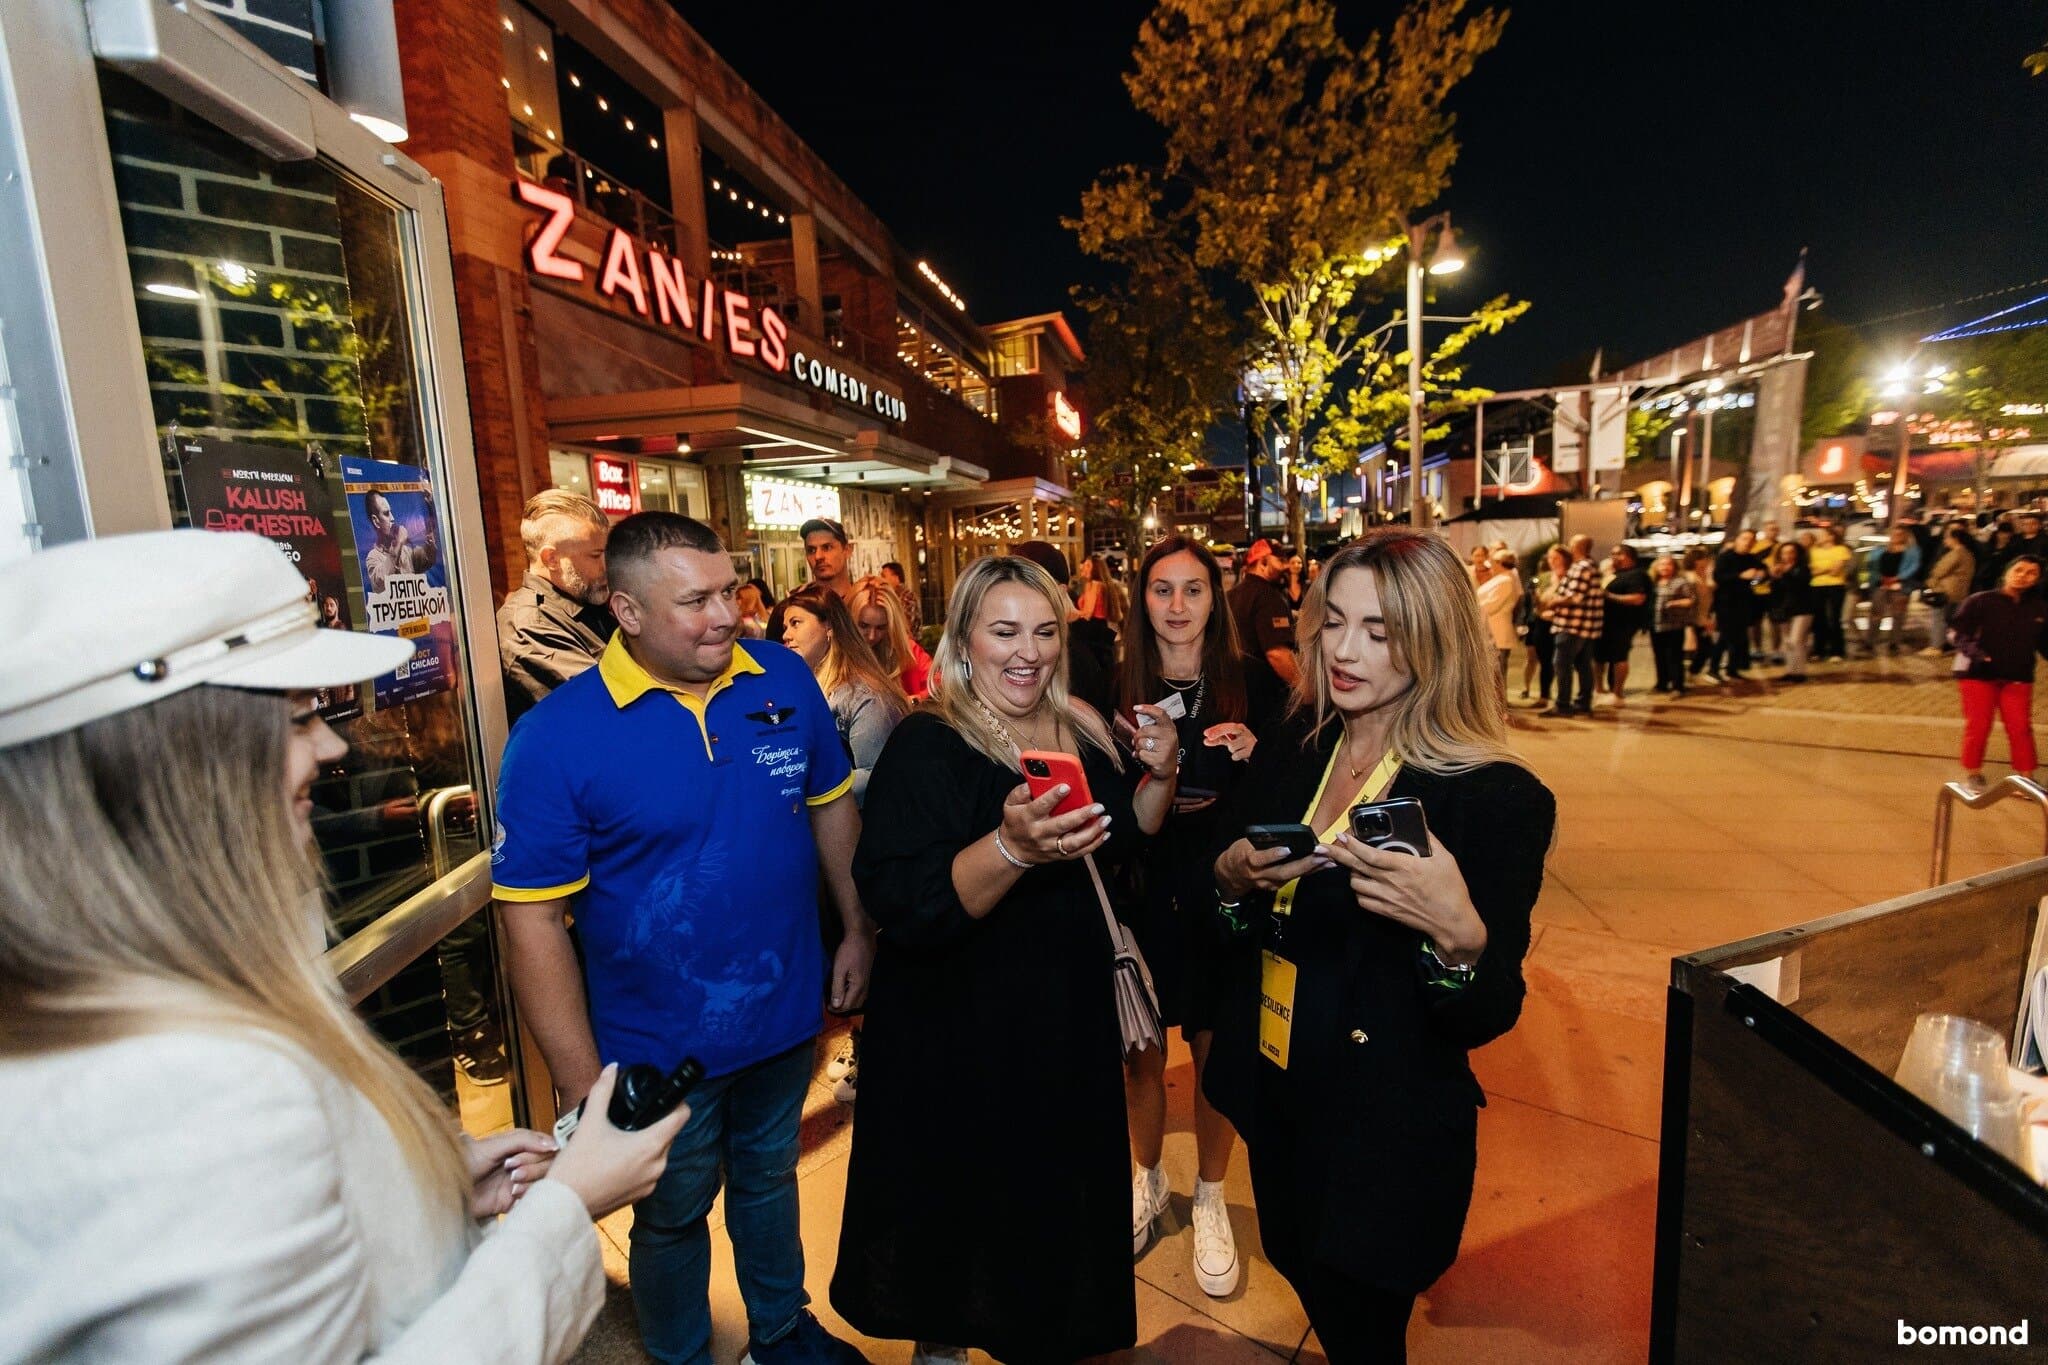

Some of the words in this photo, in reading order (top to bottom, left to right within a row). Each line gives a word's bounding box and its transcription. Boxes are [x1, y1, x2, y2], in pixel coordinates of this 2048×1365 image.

[516, 179, 788, 372] ZANIES
[794, 352, 867, 406] COMEDY
[875, 390, 907, 422] CLUB
[599, 461, 623, 483] Box
[225, 486, 307, 511] KALUSH
[390, 579, 426, 600] ЛЯПІС
[373, 592, 446, 622] ТРУБЕЦКОЙ
[411, 656, 439, 670] CHICAGO
